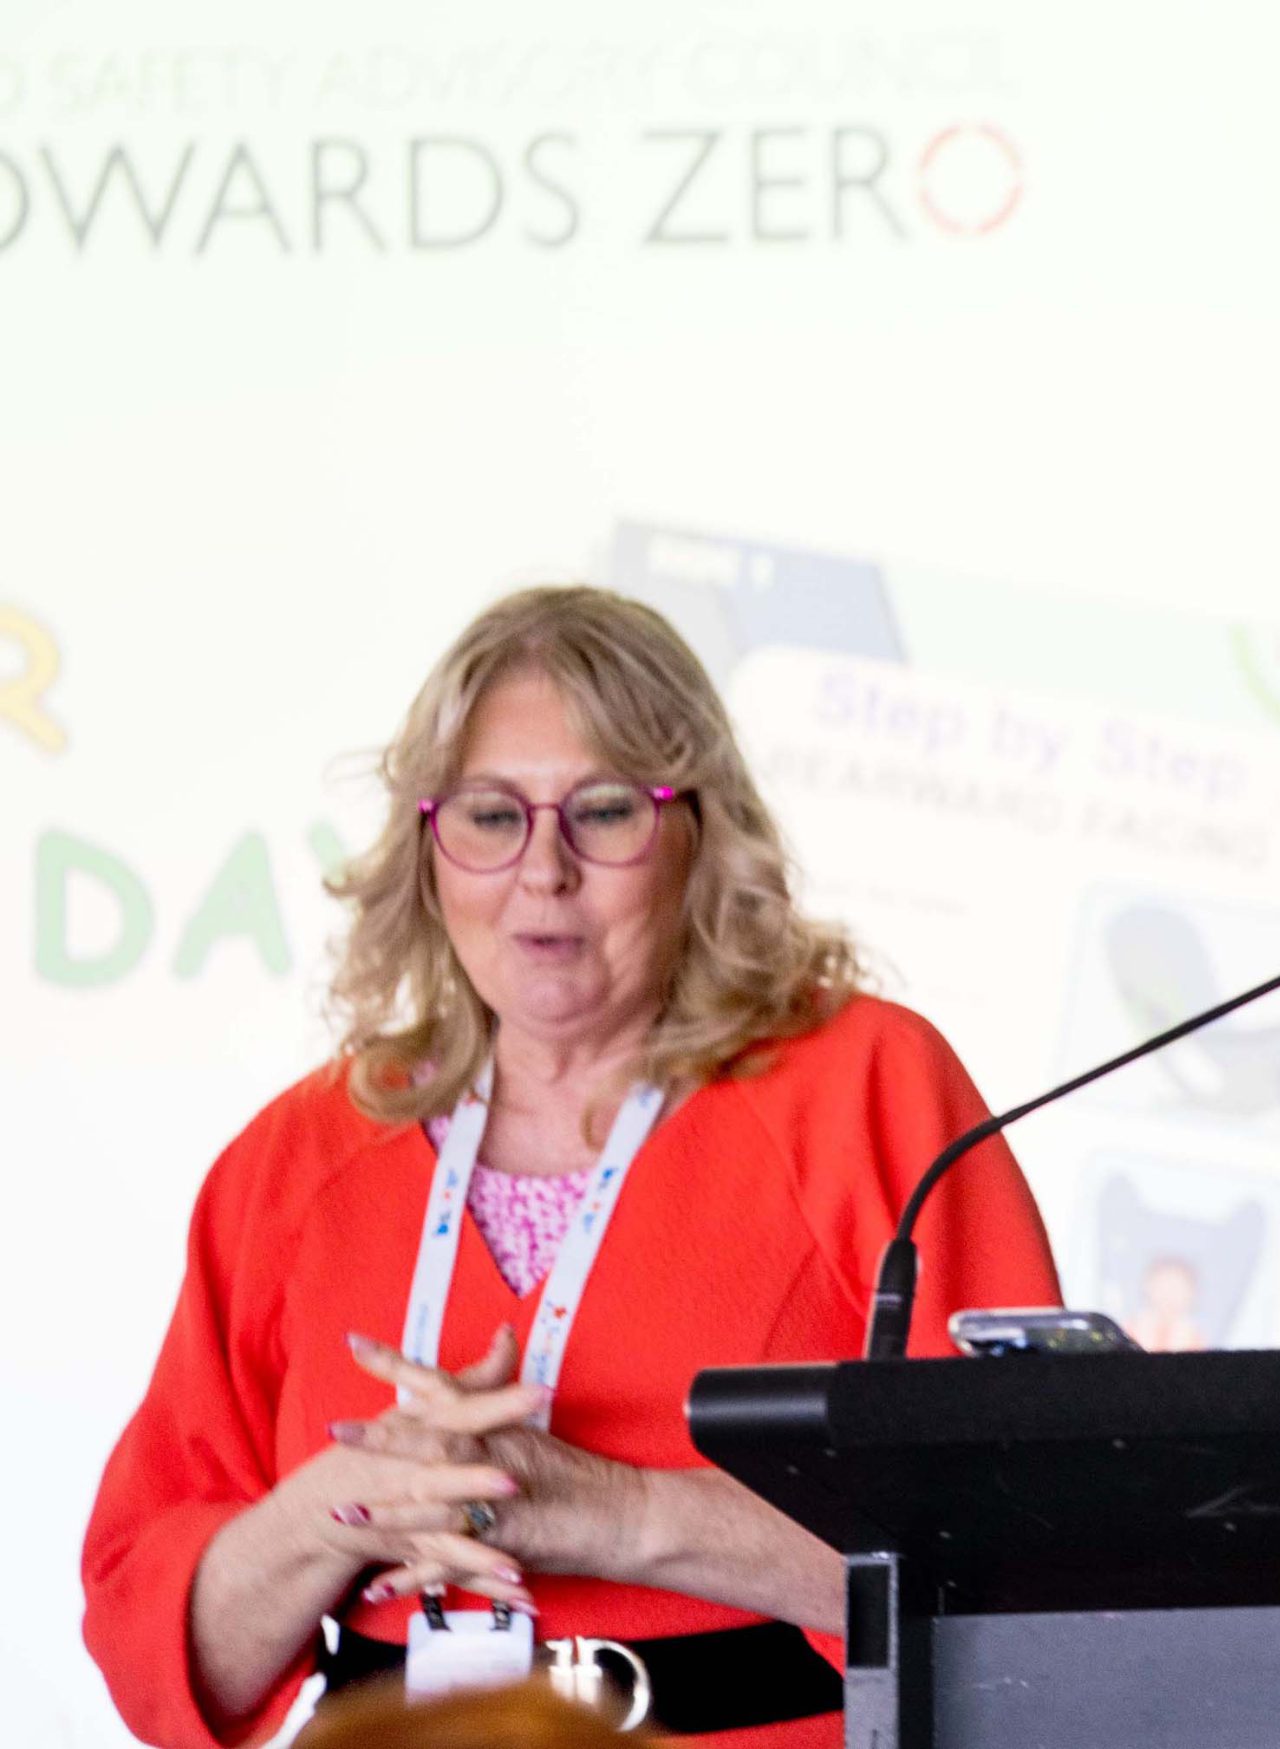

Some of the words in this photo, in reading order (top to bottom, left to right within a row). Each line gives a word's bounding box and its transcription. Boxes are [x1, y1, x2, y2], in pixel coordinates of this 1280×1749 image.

[46, 44, 298, 120] SAFETY
[312, 36, 664, 113] ADVISORY
[683, 25, 1022, 105] COUNCIL
[638, 117, 1026, 250] ZERO
[814, 668, 969, 757] Step
[987, 698, 1072, 778] by
[1092, 716, 1251, 805] Step
[765, 740, 1066, 836] REARWARD
[1080, 796, 1270, 872] FACING
